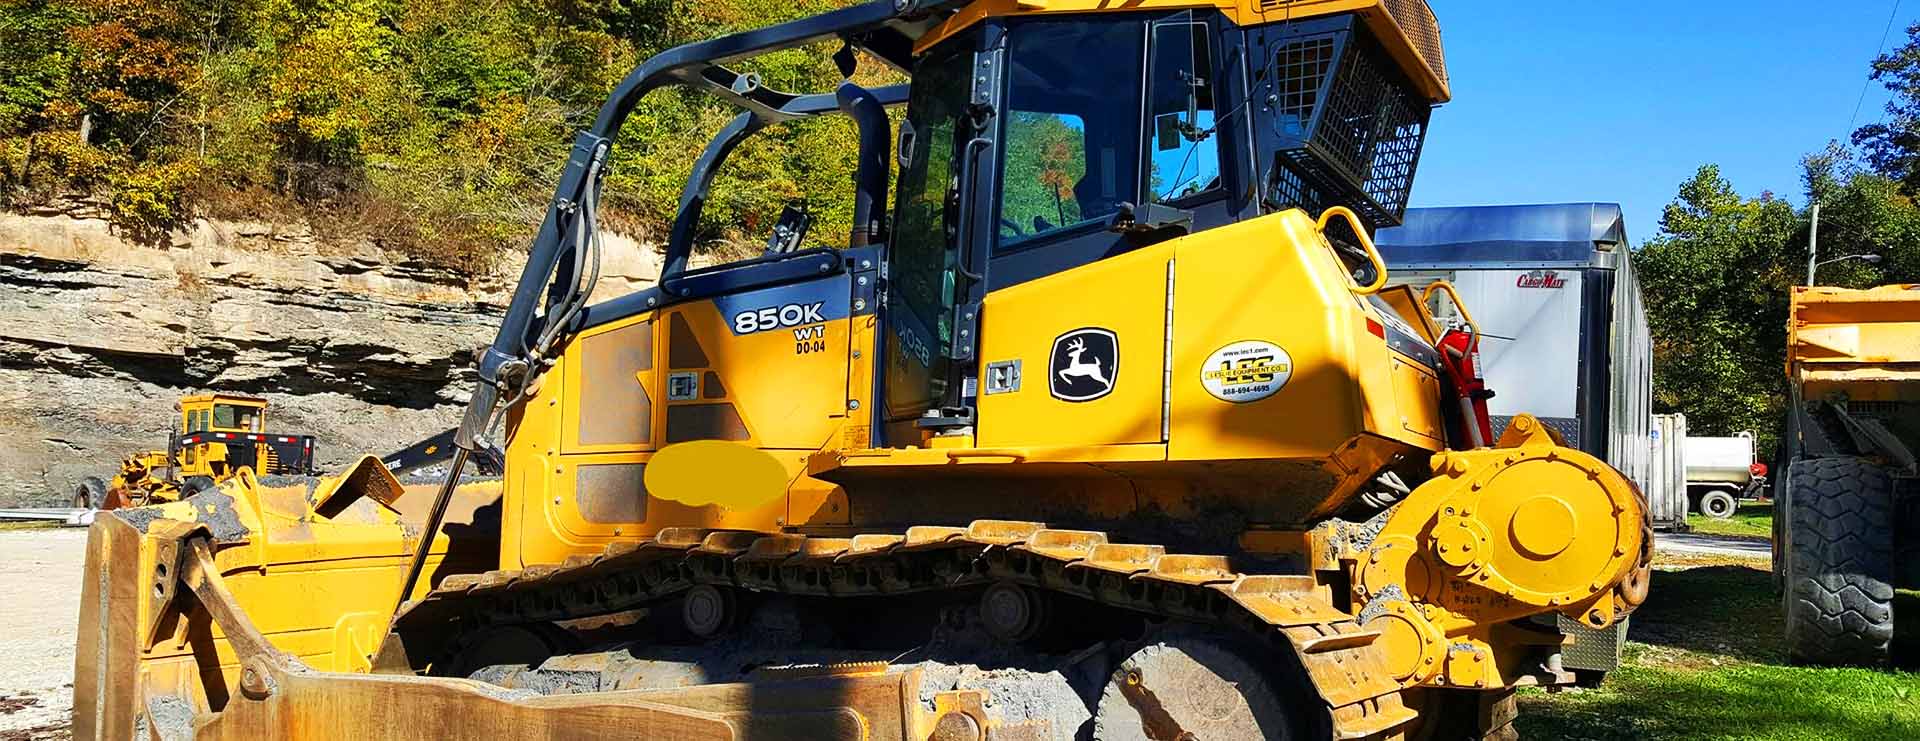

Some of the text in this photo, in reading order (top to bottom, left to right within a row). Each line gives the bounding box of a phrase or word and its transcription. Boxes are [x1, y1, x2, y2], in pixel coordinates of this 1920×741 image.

[734, 301, 825, 335] 850K
[794, 325, 825, 342] WT
[1221, 355, 1274, 385] LEC
